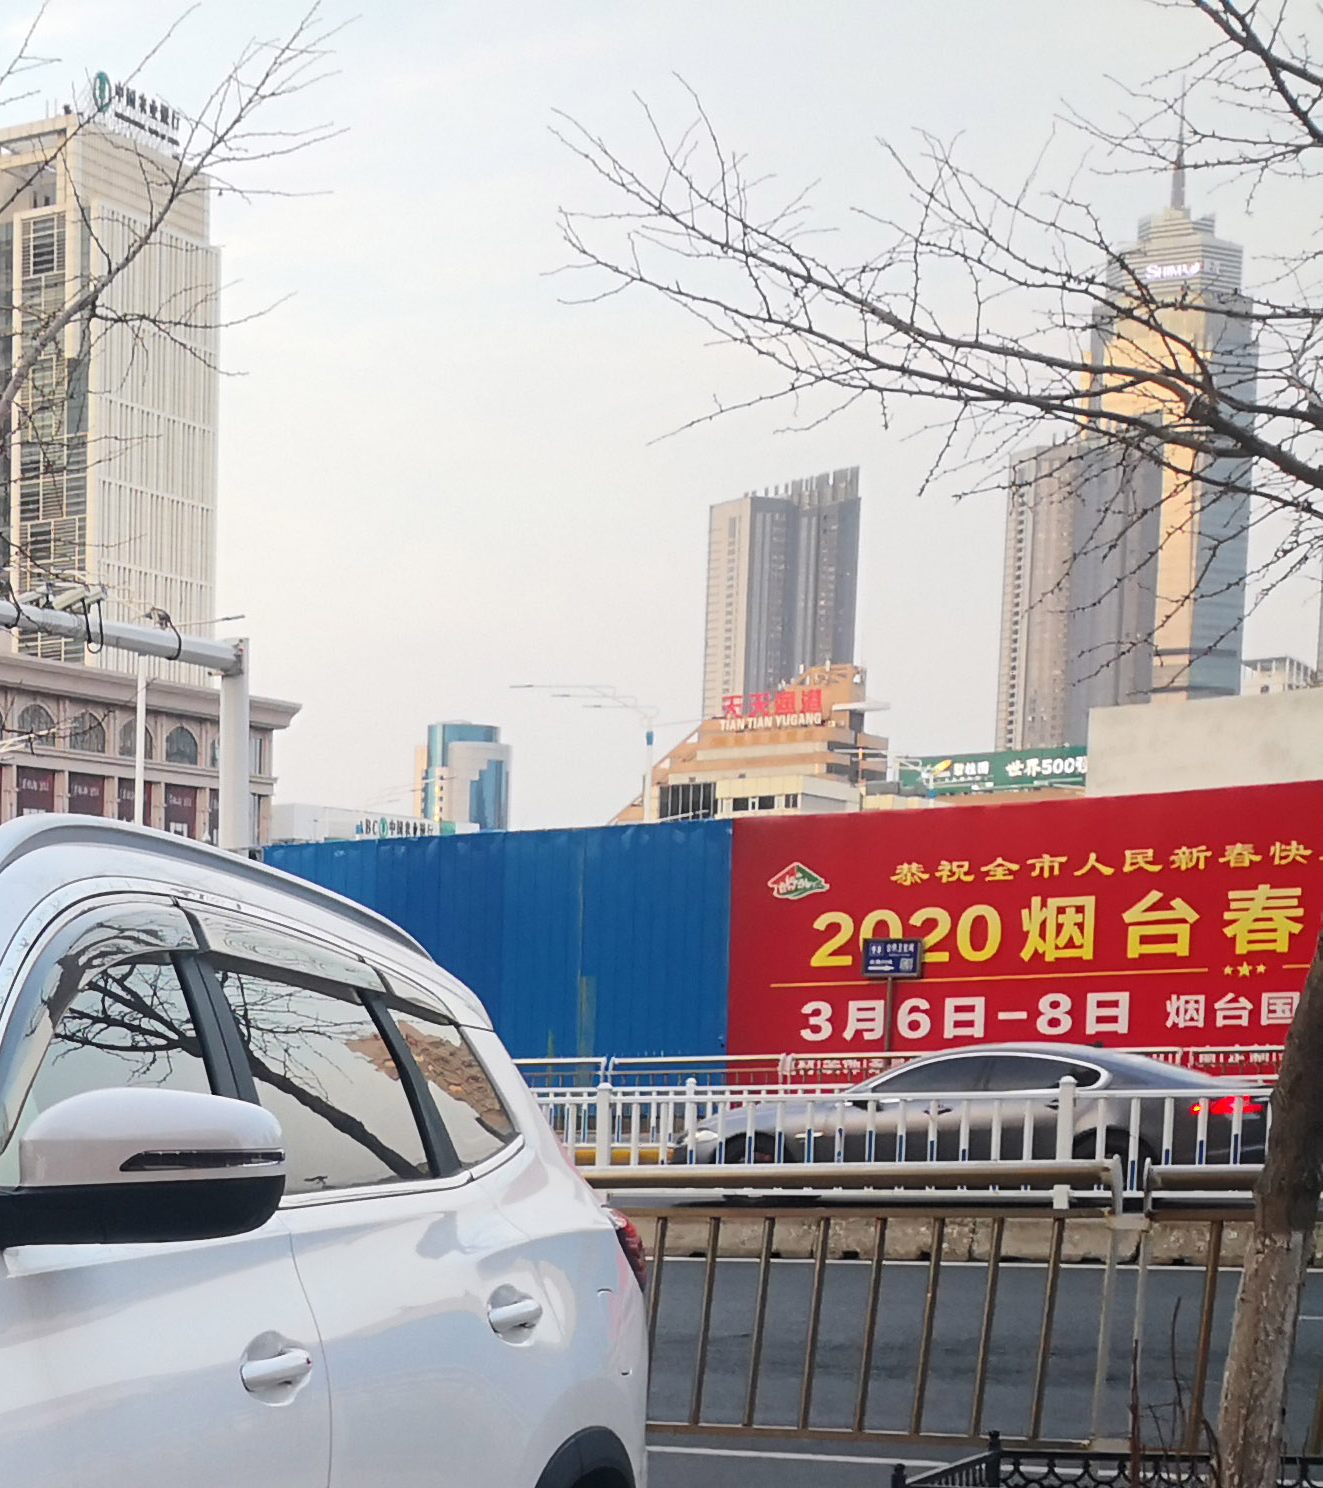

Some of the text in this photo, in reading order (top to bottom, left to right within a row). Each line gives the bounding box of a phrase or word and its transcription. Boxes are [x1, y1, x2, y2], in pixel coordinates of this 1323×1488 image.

[720, 712, 822, 732] TIAN TIAN YUGANG
[889, 839, 1323, 886] 恭祝全市人民新春快
